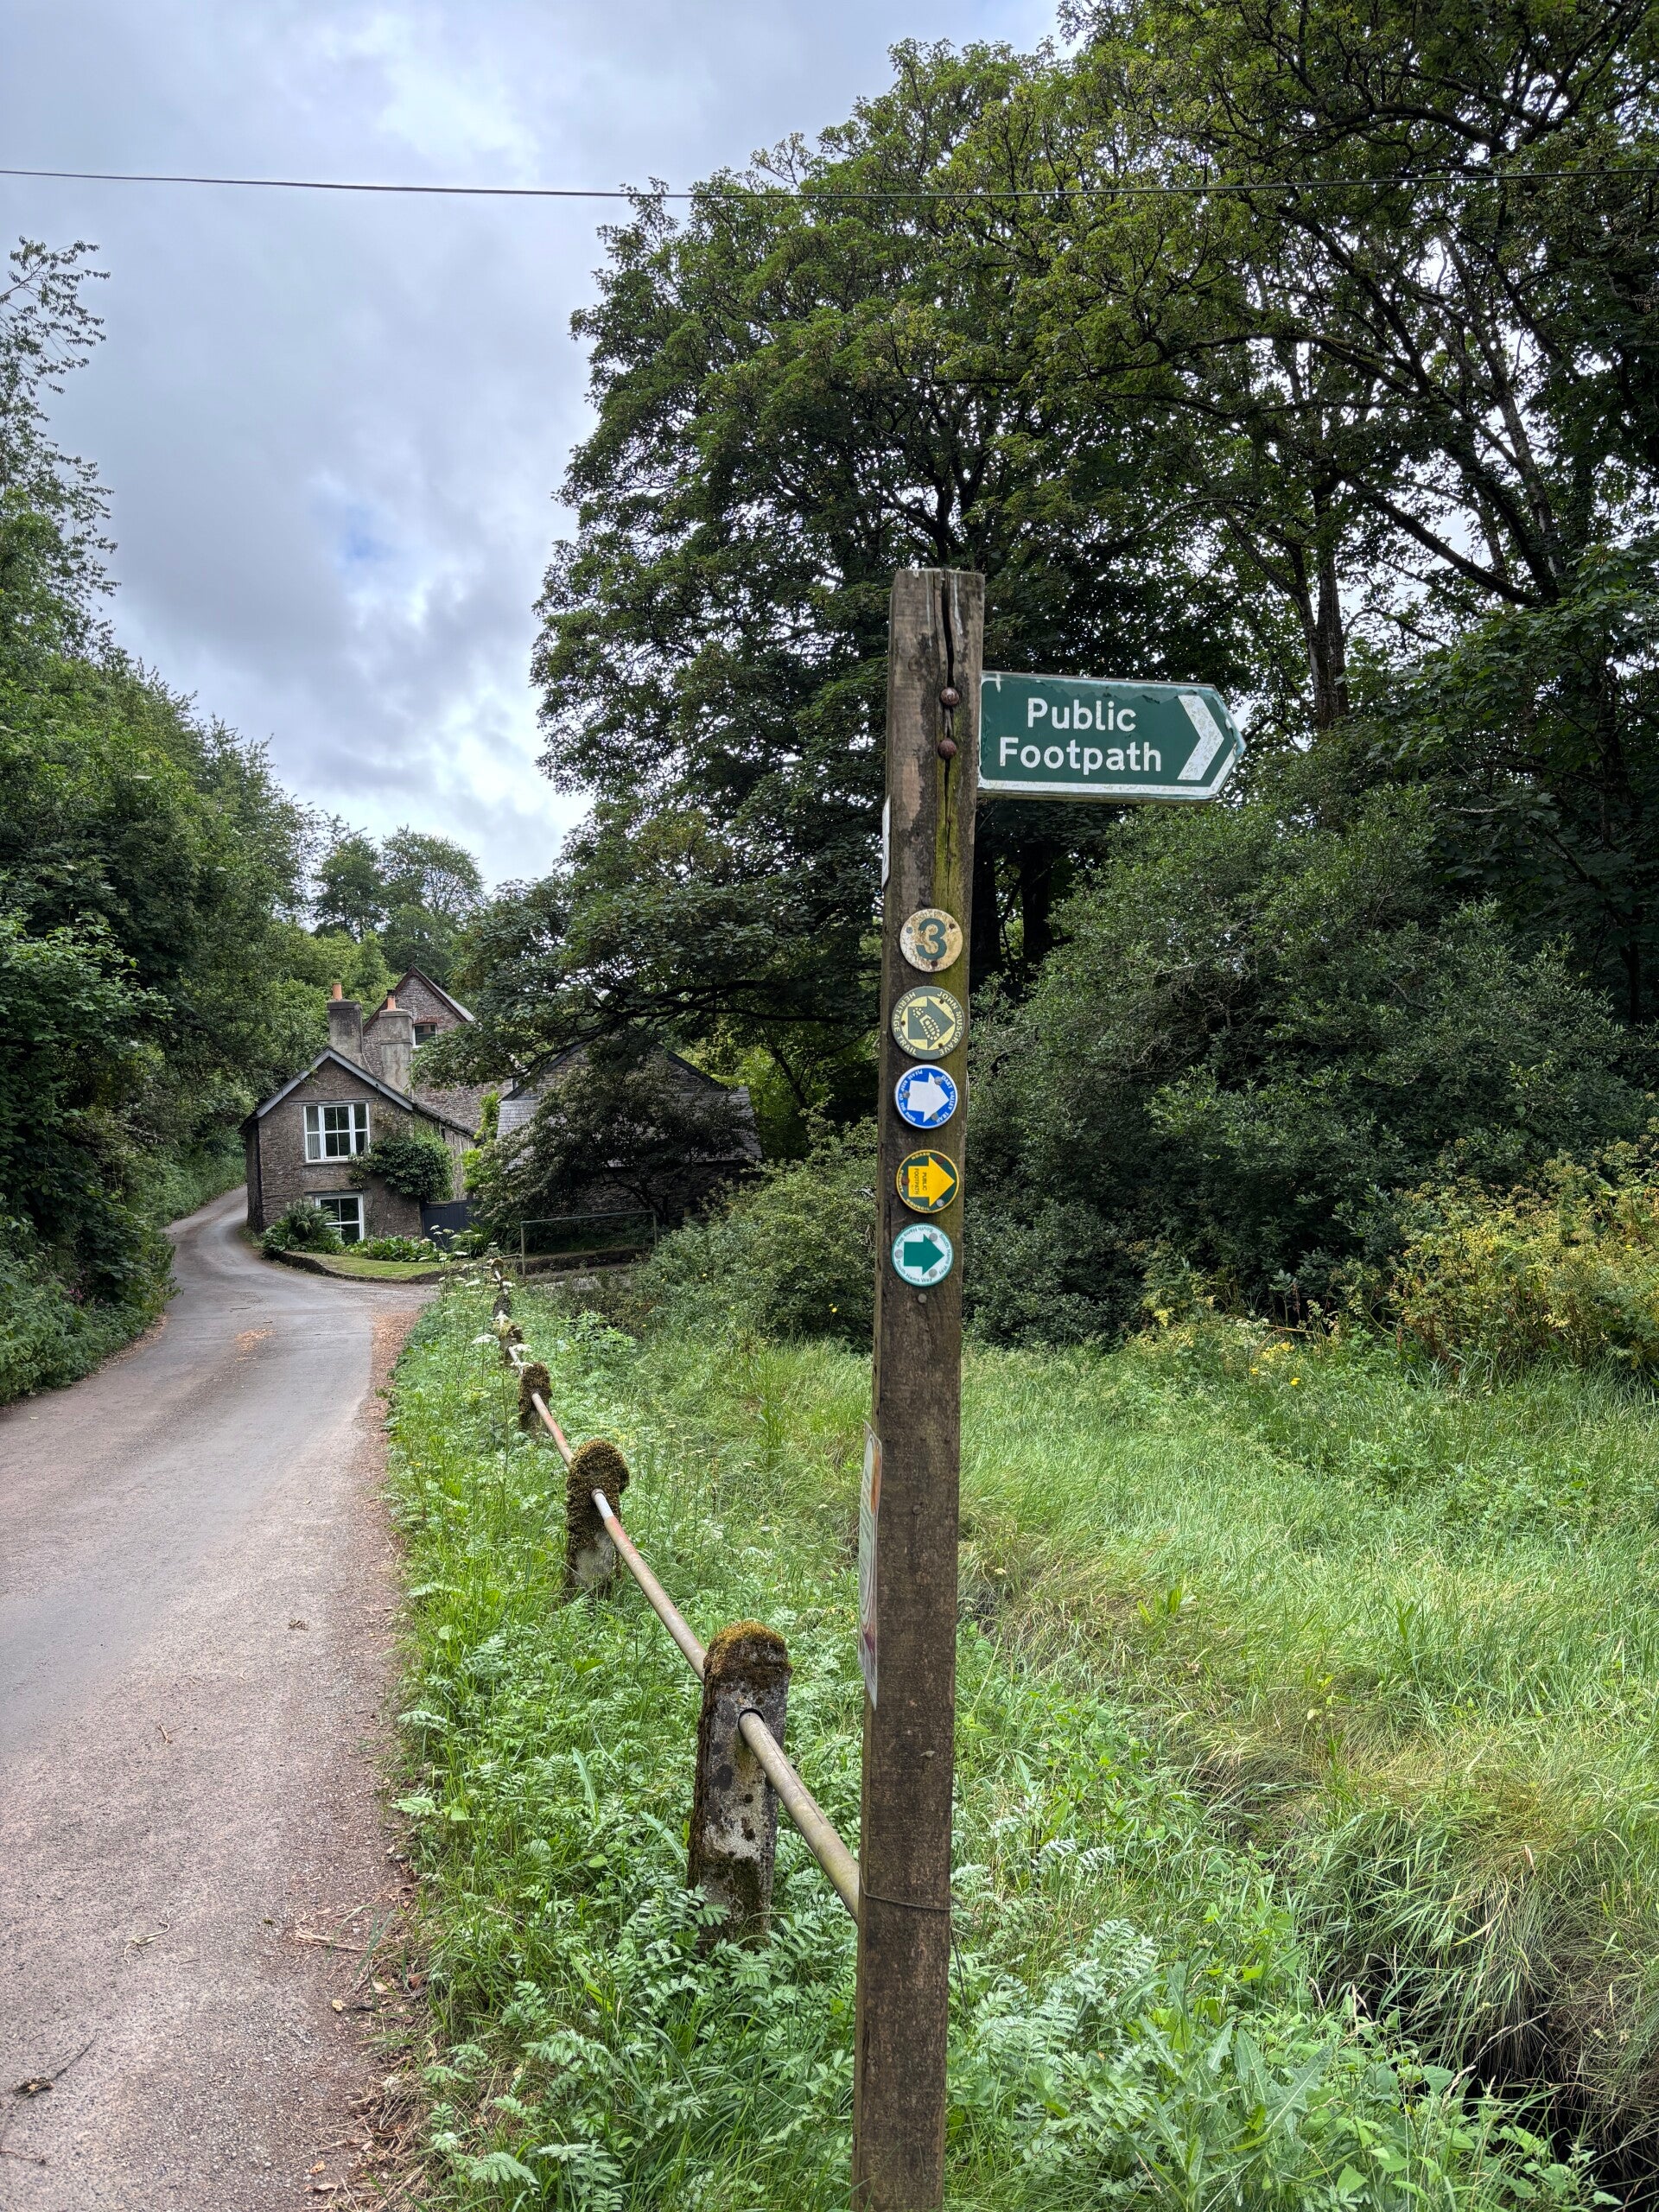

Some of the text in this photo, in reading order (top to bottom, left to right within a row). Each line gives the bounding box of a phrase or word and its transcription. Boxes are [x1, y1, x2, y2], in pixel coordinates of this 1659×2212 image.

[1027, 696, 1137, 732] Public
[999, 736, 1161, 776] Footpath
[916, 918, 947, 961] 3
[893, 991, 918, 1056] HERITAGE TRAIL
[937, 991, 963, 1056] JOHN MUSGRAVE
[936, 1075, 956, 1123] DART VALLEY TRAIL
[911, 1152, 931, 1160] DEVON
[906, 1198, 931, 1211] COUNCIL
